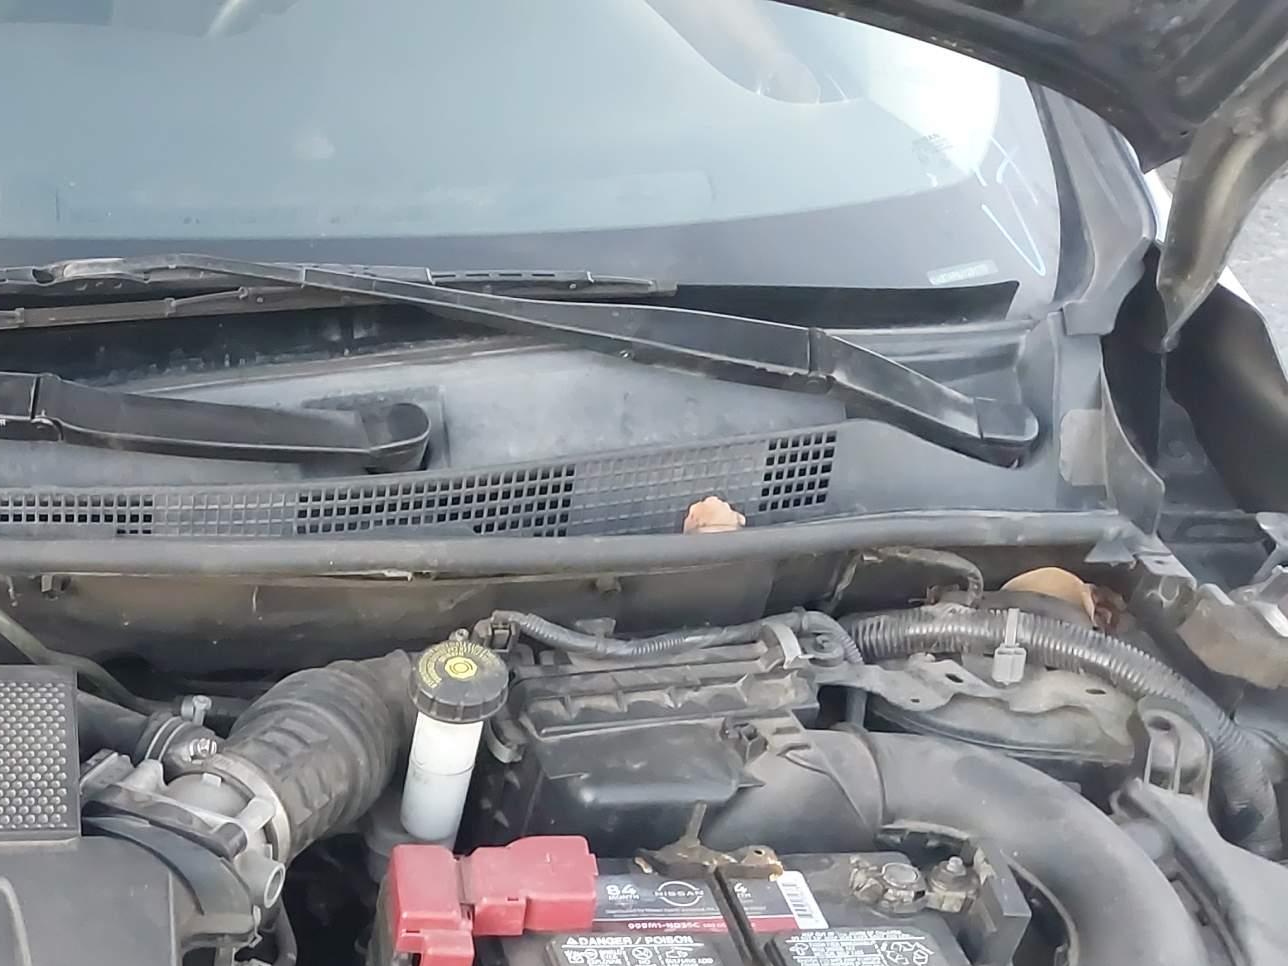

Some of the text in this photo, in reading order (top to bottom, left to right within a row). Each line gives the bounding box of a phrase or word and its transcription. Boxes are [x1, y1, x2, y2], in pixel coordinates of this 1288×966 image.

[654, 889, 704, 897] NISSAN
[579, 936, 633, 945] DANGER
[644, 935, 694, 945] POISON
